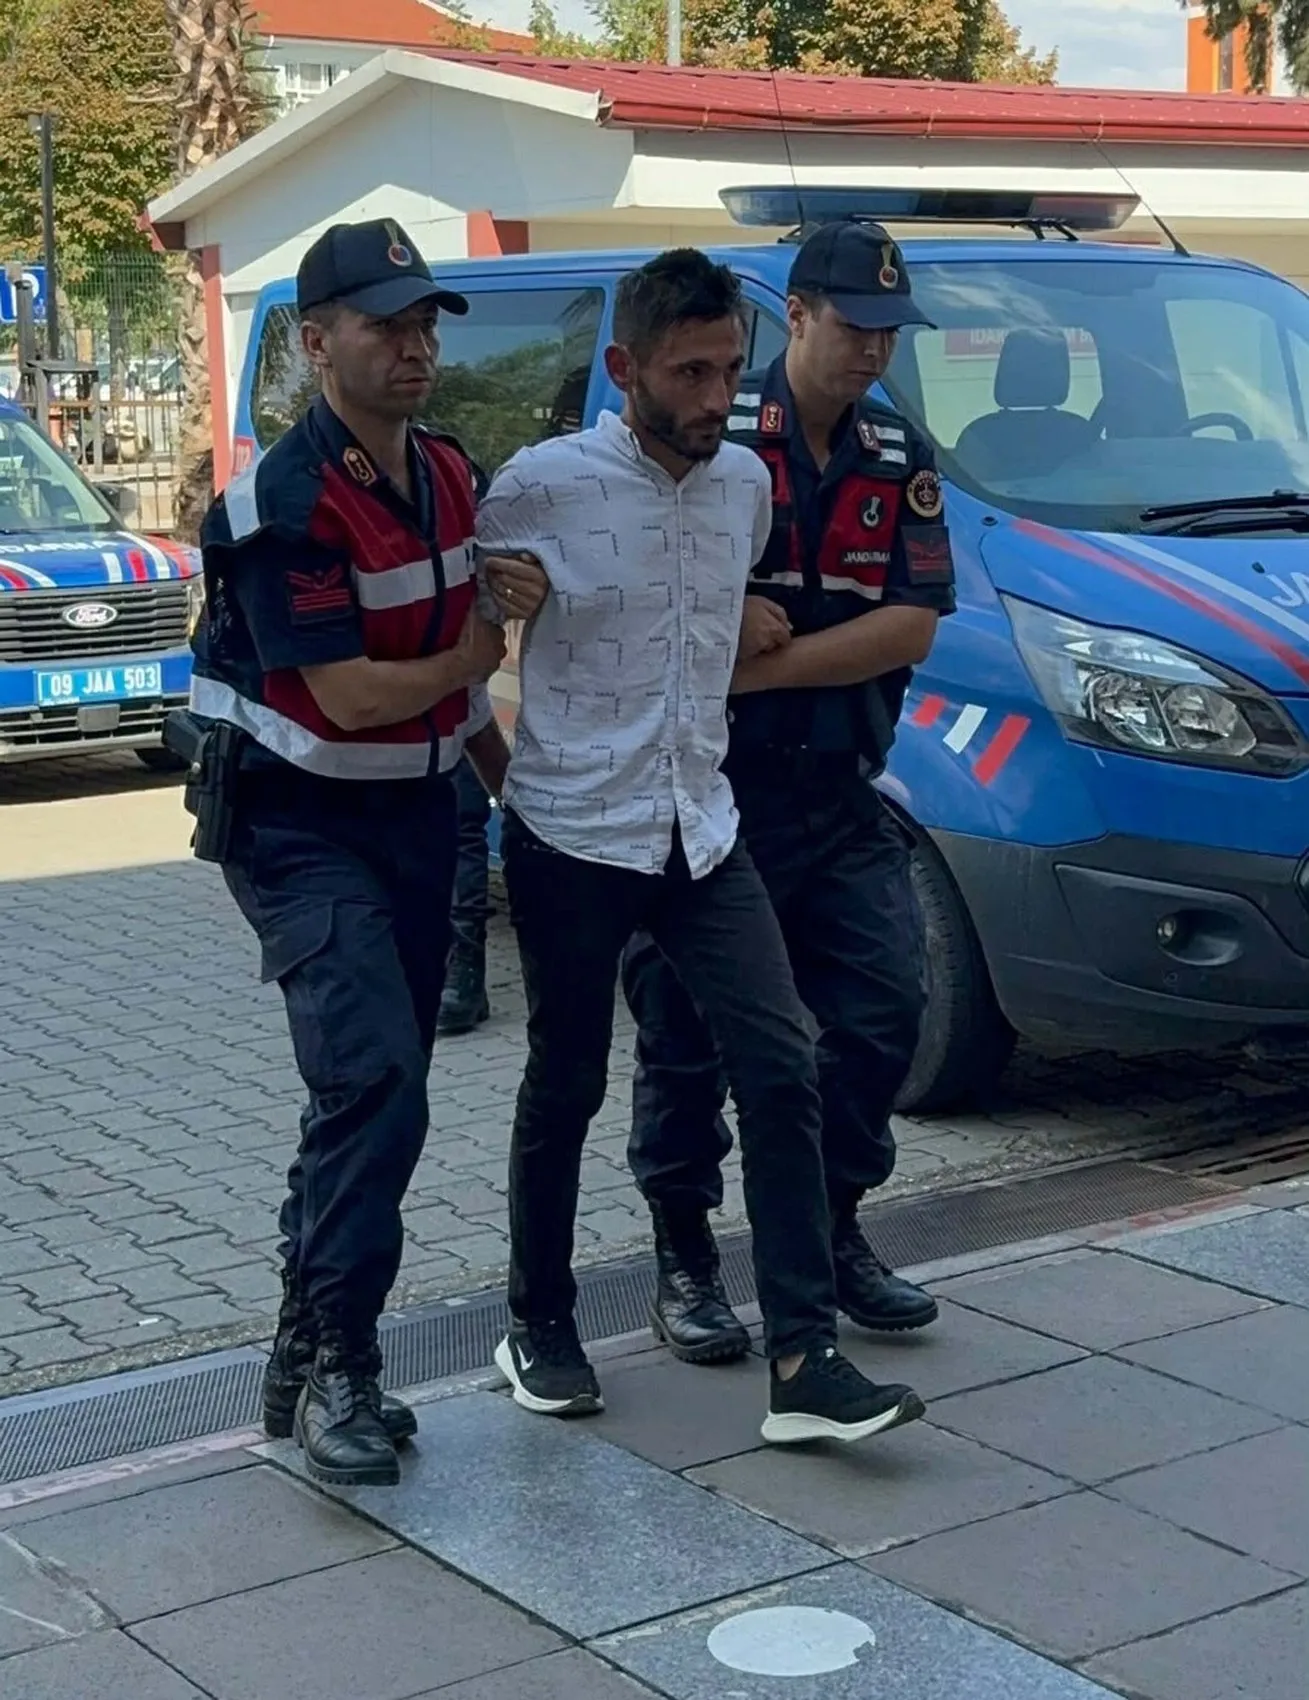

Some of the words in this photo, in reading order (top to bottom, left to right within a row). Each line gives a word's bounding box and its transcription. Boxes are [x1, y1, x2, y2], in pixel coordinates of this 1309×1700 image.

[75, 606, 108, 624] Ford
[51, 673, 73, 697] 09
[82, 670, 116, 694] JAA
[124, 666, 157, 690] 503
